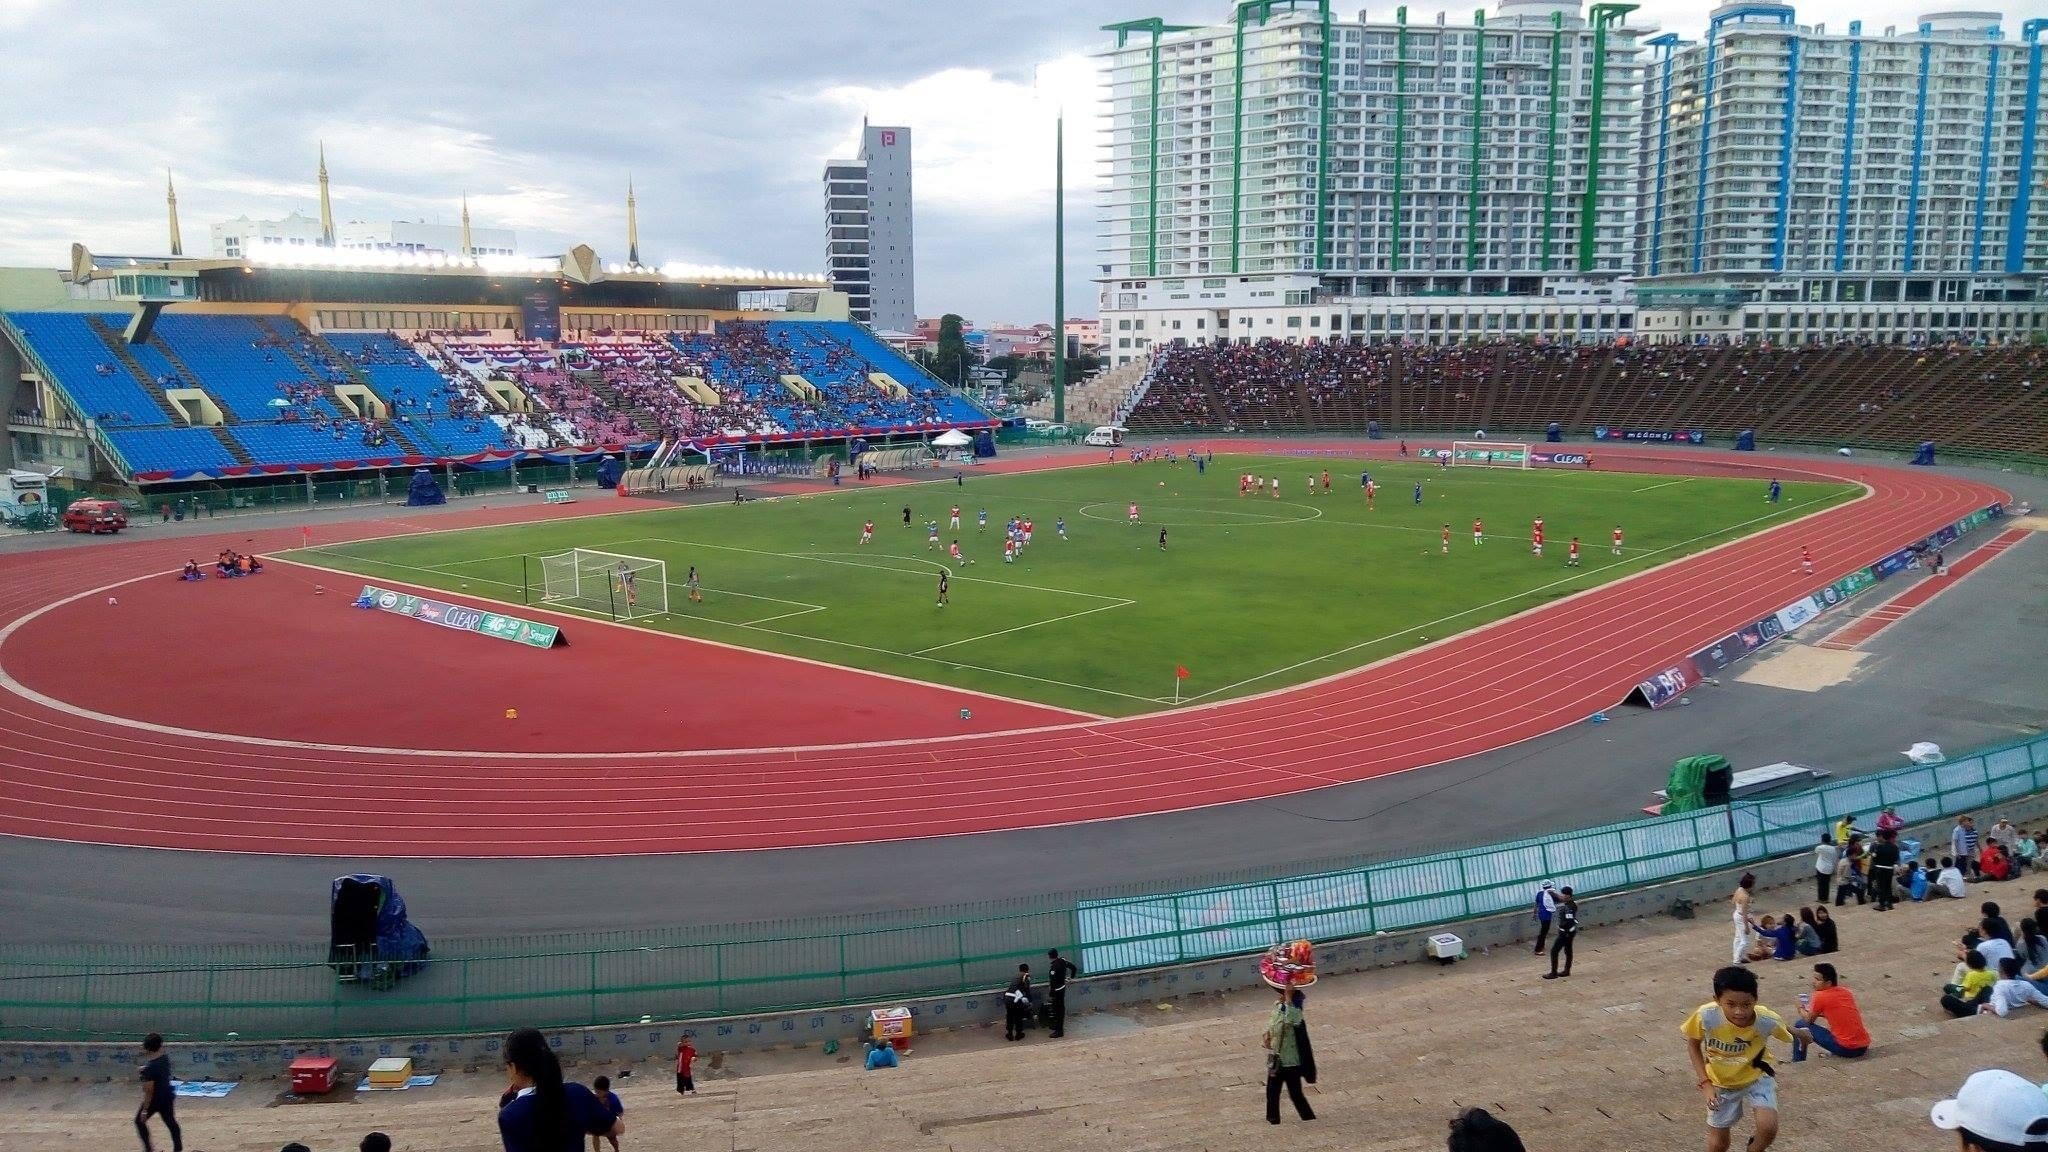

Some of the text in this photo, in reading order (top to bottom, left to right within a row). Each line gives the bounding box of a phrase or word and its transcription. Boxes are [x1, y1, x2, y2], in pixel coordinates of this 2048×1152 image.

[1553, 453, 1584, 464] CLEAR
[445, 606, 480, 631] CLEAR
[529, 629, 552, 643] Smart
[717, 1025, 732, 1036] DW
